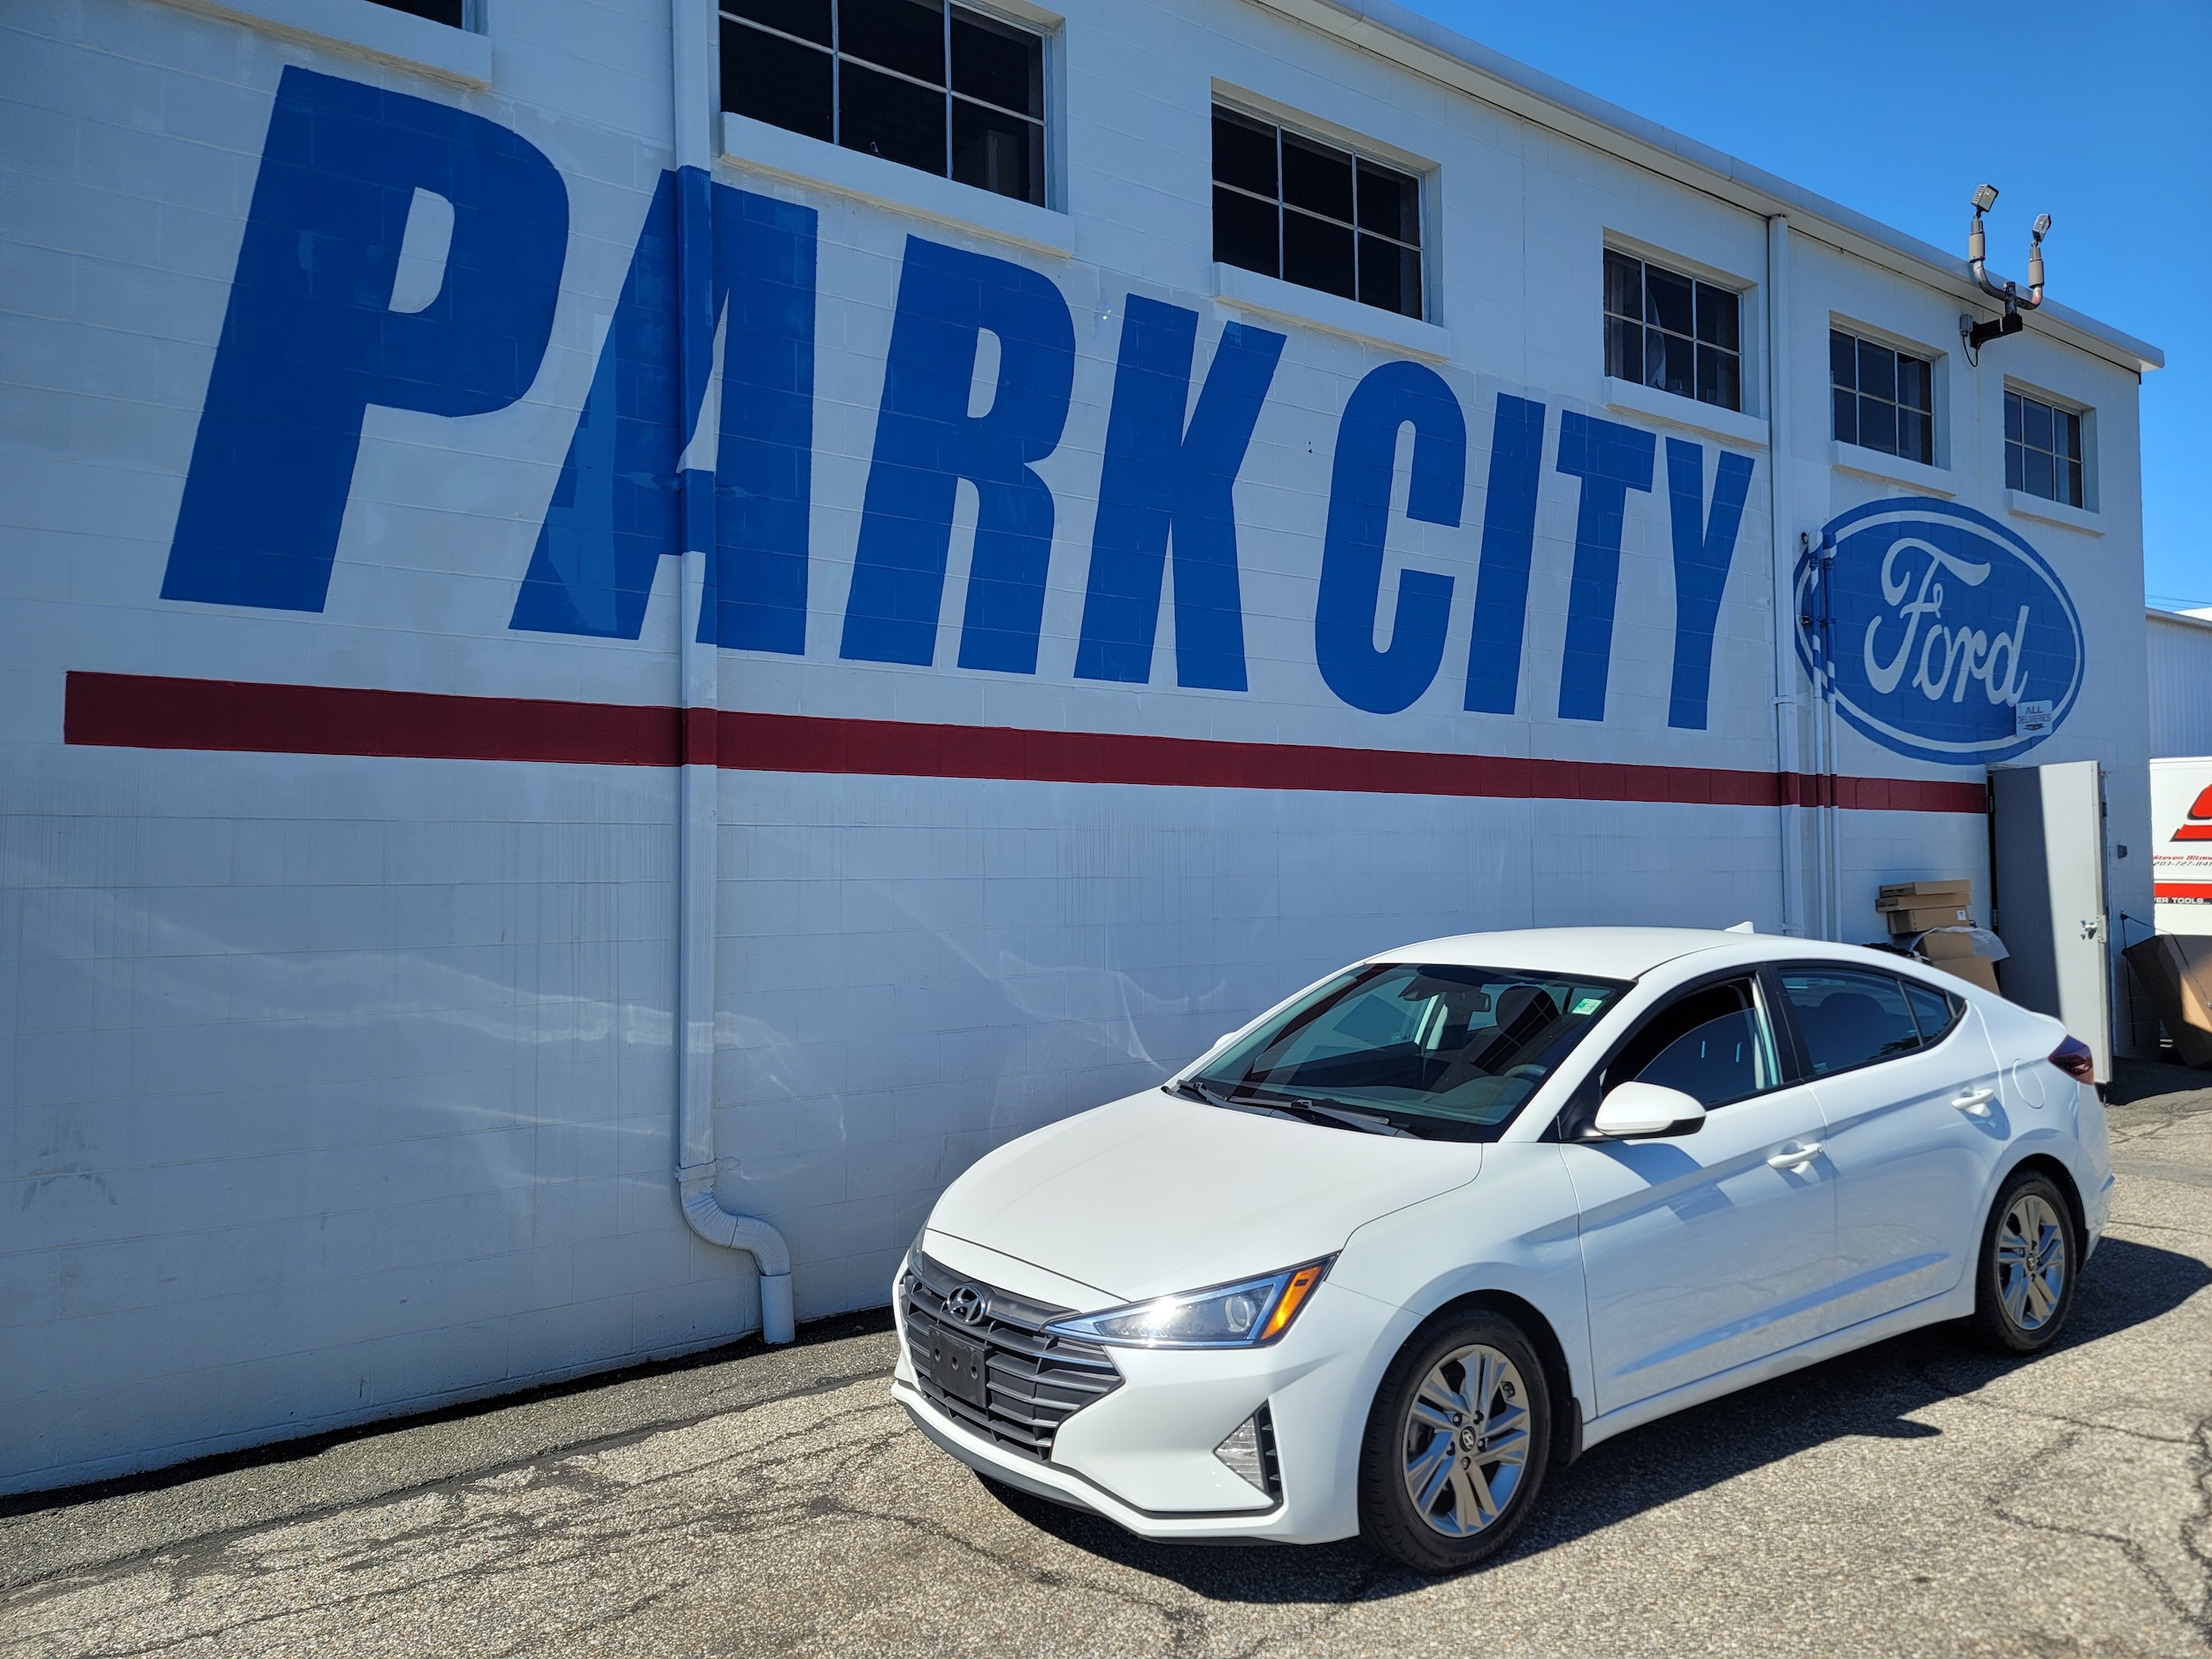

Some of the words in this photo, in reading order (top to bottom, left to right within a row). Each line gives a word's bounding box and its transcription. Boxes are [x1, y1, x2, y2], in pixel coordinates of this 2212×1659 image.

[159, 65, 1286, 692] PARK
[1315, 360, 1755, 729] CITY
[1864, 537, 2030, 707] Ford
[2017, 713, 2051, 724] DELIVERIES
[2025, 705, 2043, 714] ALL
